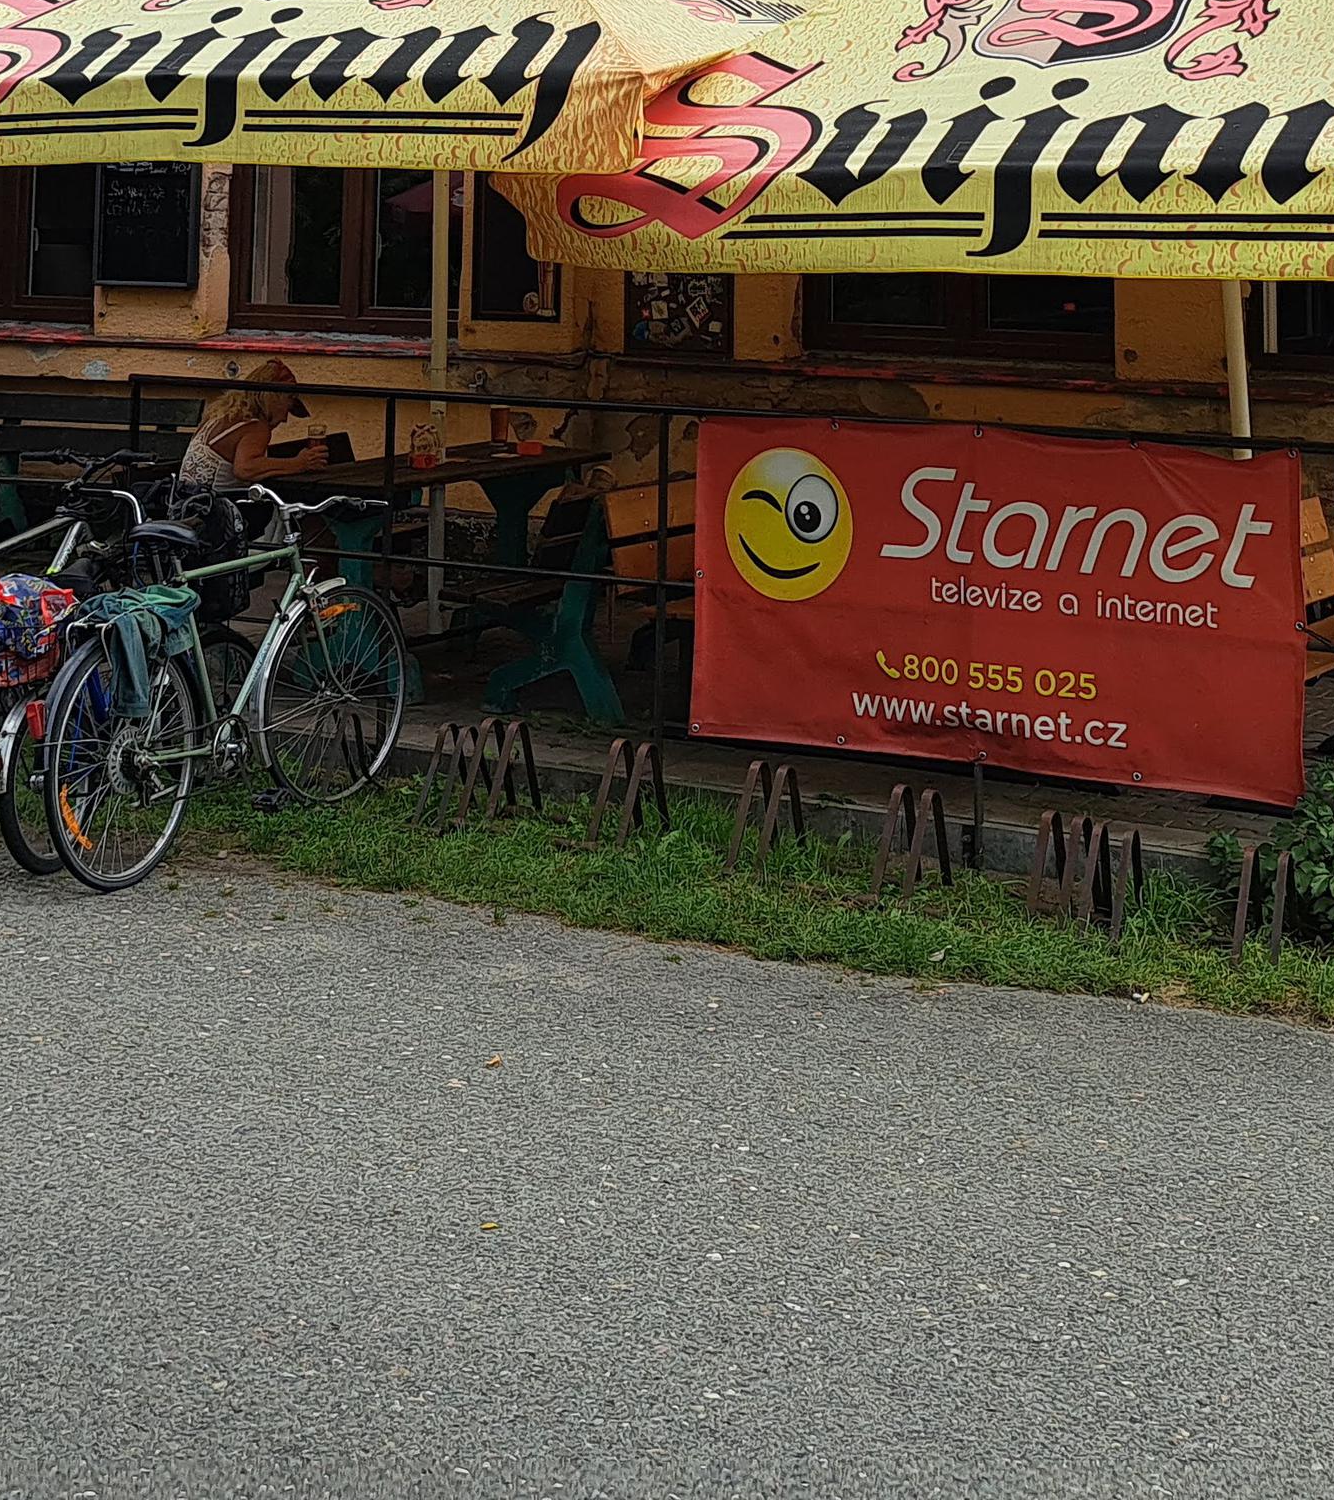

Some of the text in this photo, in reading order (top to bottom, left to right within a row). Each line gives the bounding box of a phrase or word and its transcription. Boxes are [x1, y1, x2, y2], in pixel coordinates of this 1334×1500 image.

[879, 466, 1274, 589] Starnet
[930, 576, 1219, 629] televize a internet
[903, 654, 1097, 700] 800 555 025
[851, 691, 1128, 748] www.starnet.cz
